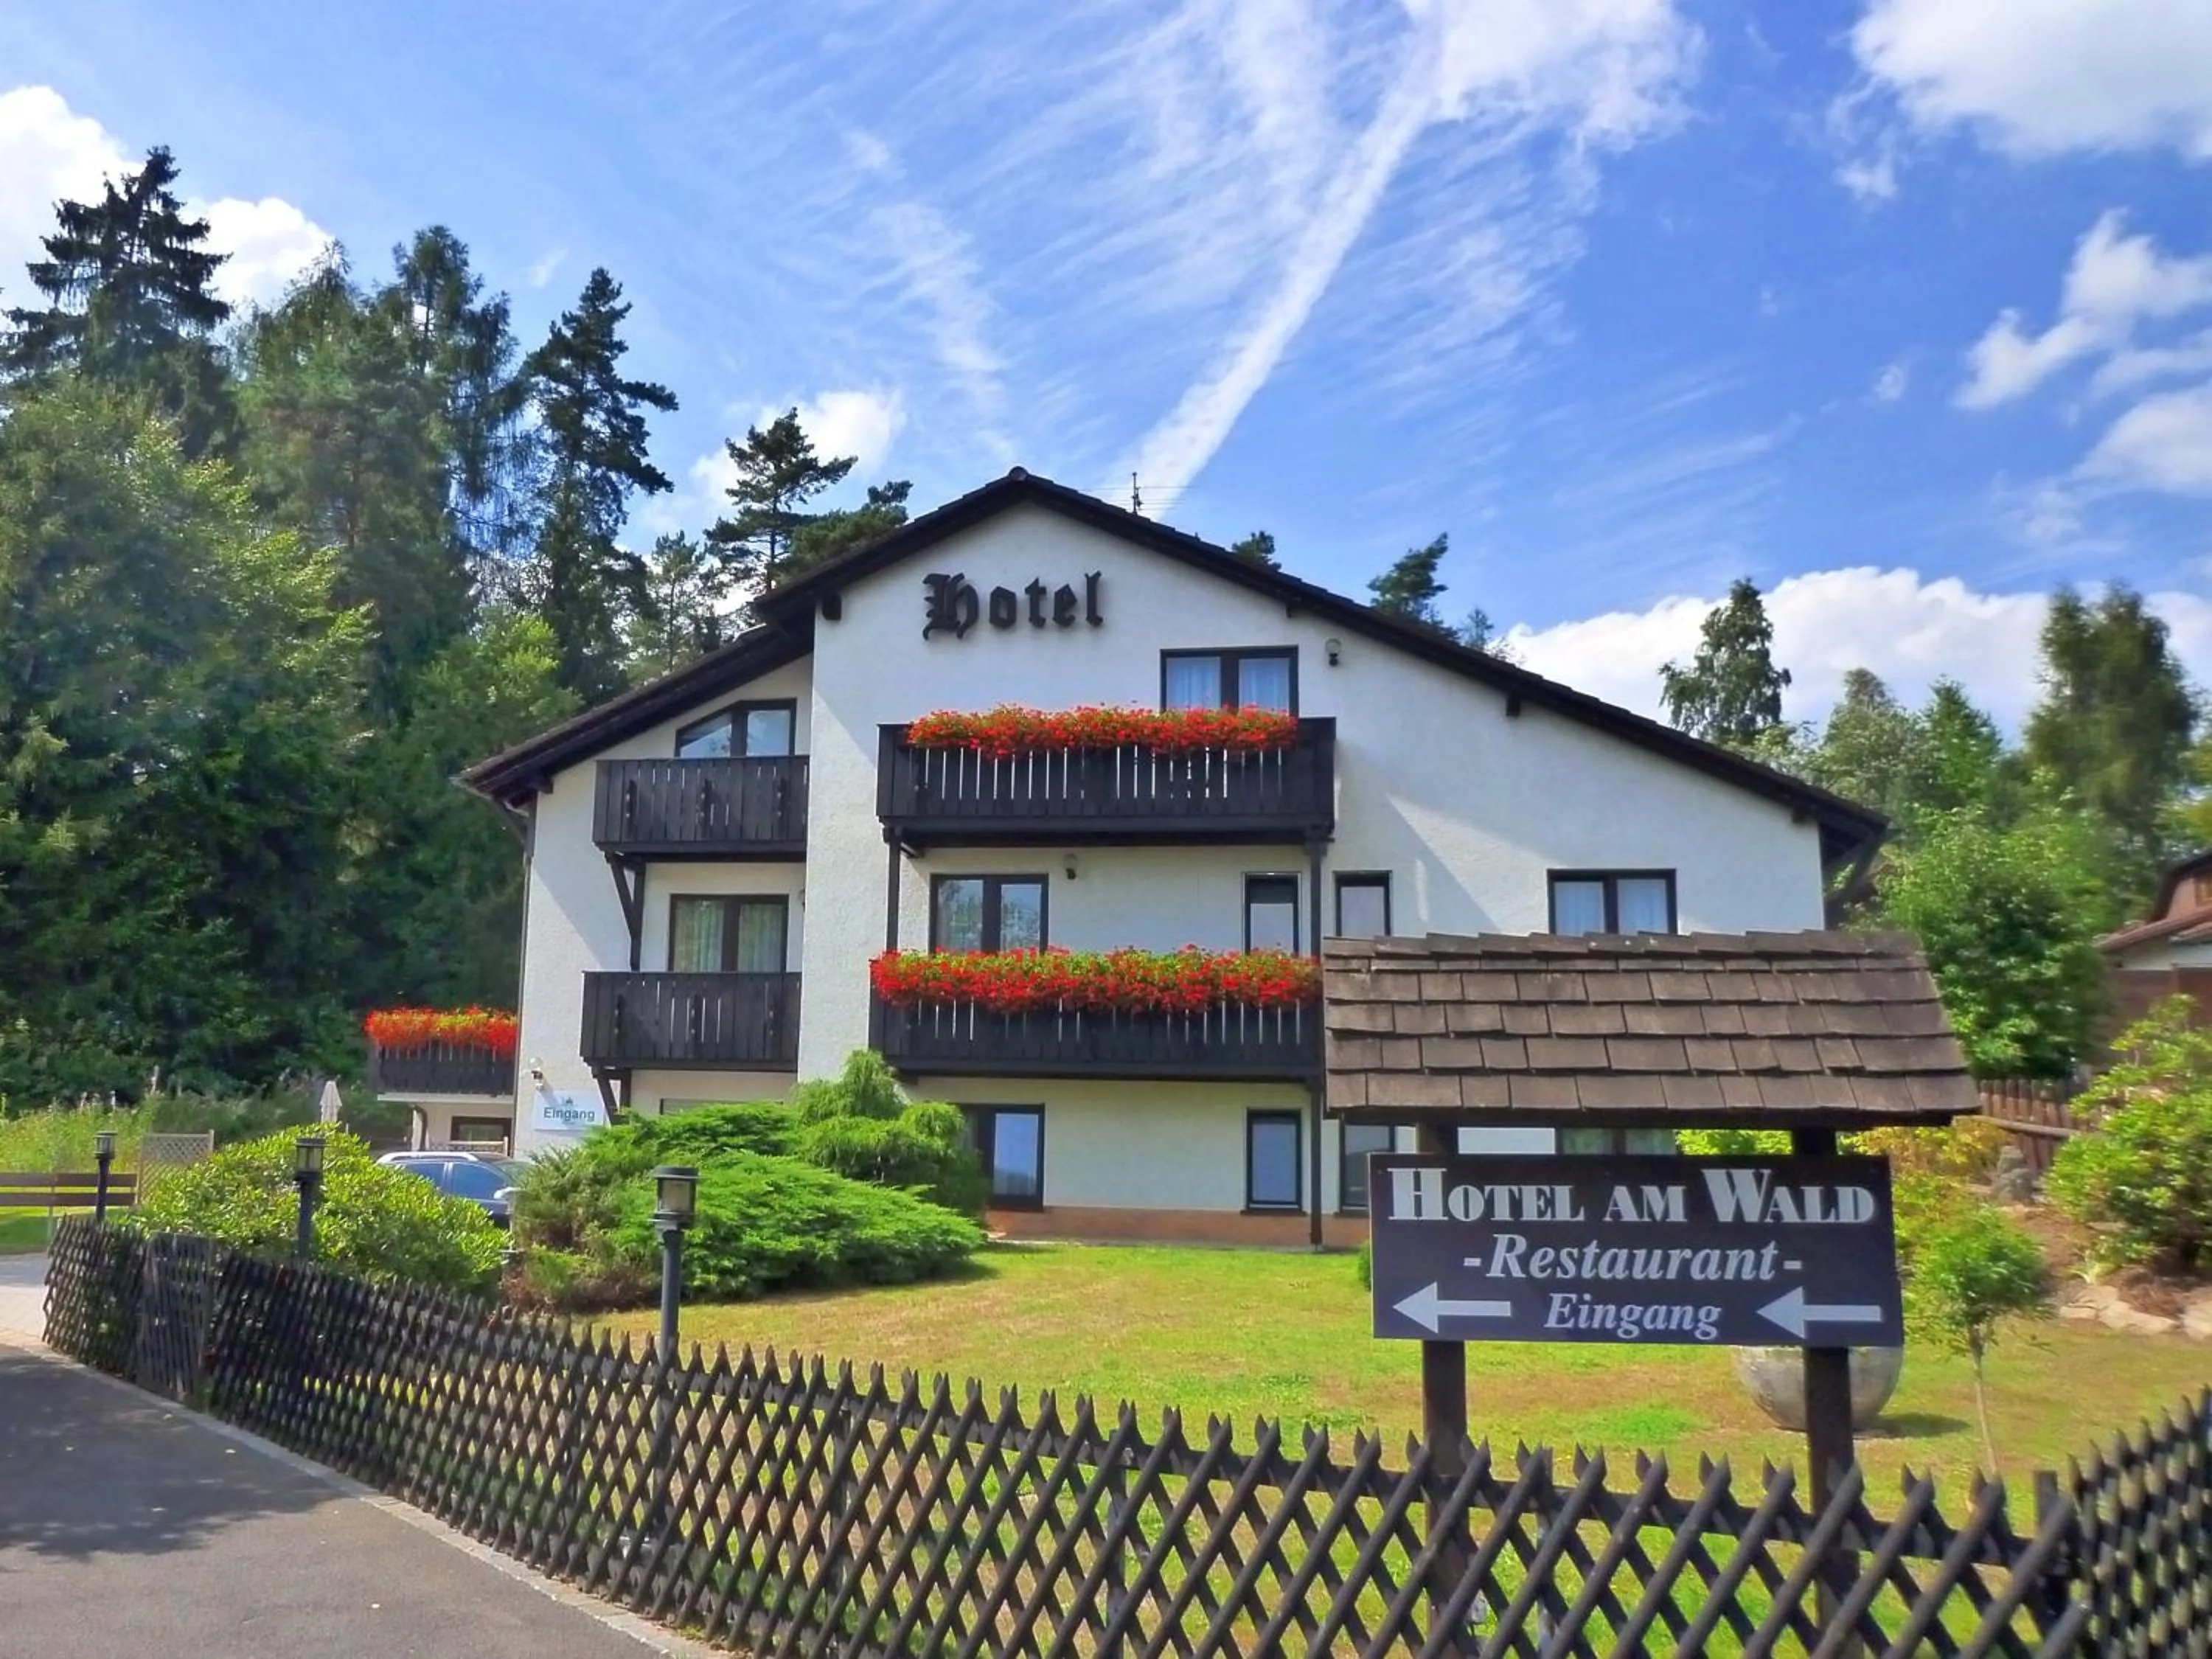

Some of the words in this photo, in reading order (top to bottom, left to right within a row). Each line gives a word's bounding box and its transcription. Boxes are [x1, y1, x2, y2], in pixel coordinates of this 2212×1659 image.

[922, 571, 1104, 641] Hotel
[543, 1107, 595, 1122] Eingang
[1386, 1167, 1585, 1222] HOTEL
[1604, 1186, 1688, 1223] AM
[1701, 1169, 1875, 1224] WALD
[1544, 1292, 1722, 1340] Eingang
